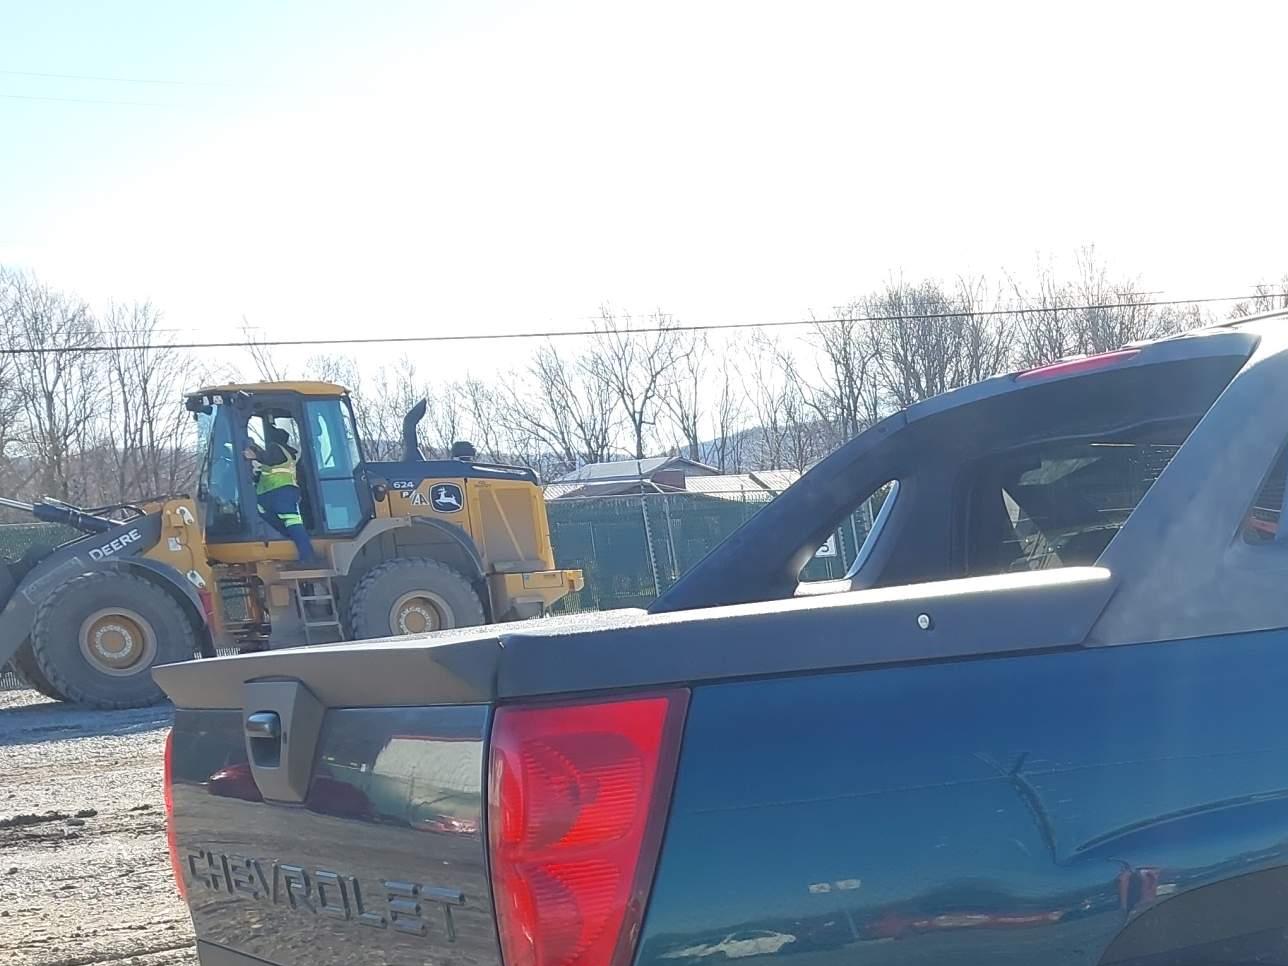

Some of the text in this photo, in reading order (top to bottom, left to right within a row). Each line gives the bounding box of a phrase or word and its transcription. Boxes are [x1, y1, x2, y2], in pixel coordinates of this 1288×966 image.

[393, 481, 414, 489] 624
[88, 528, 142, 560] DEERE
[188, 850, 466, 943] CHEVROLET
